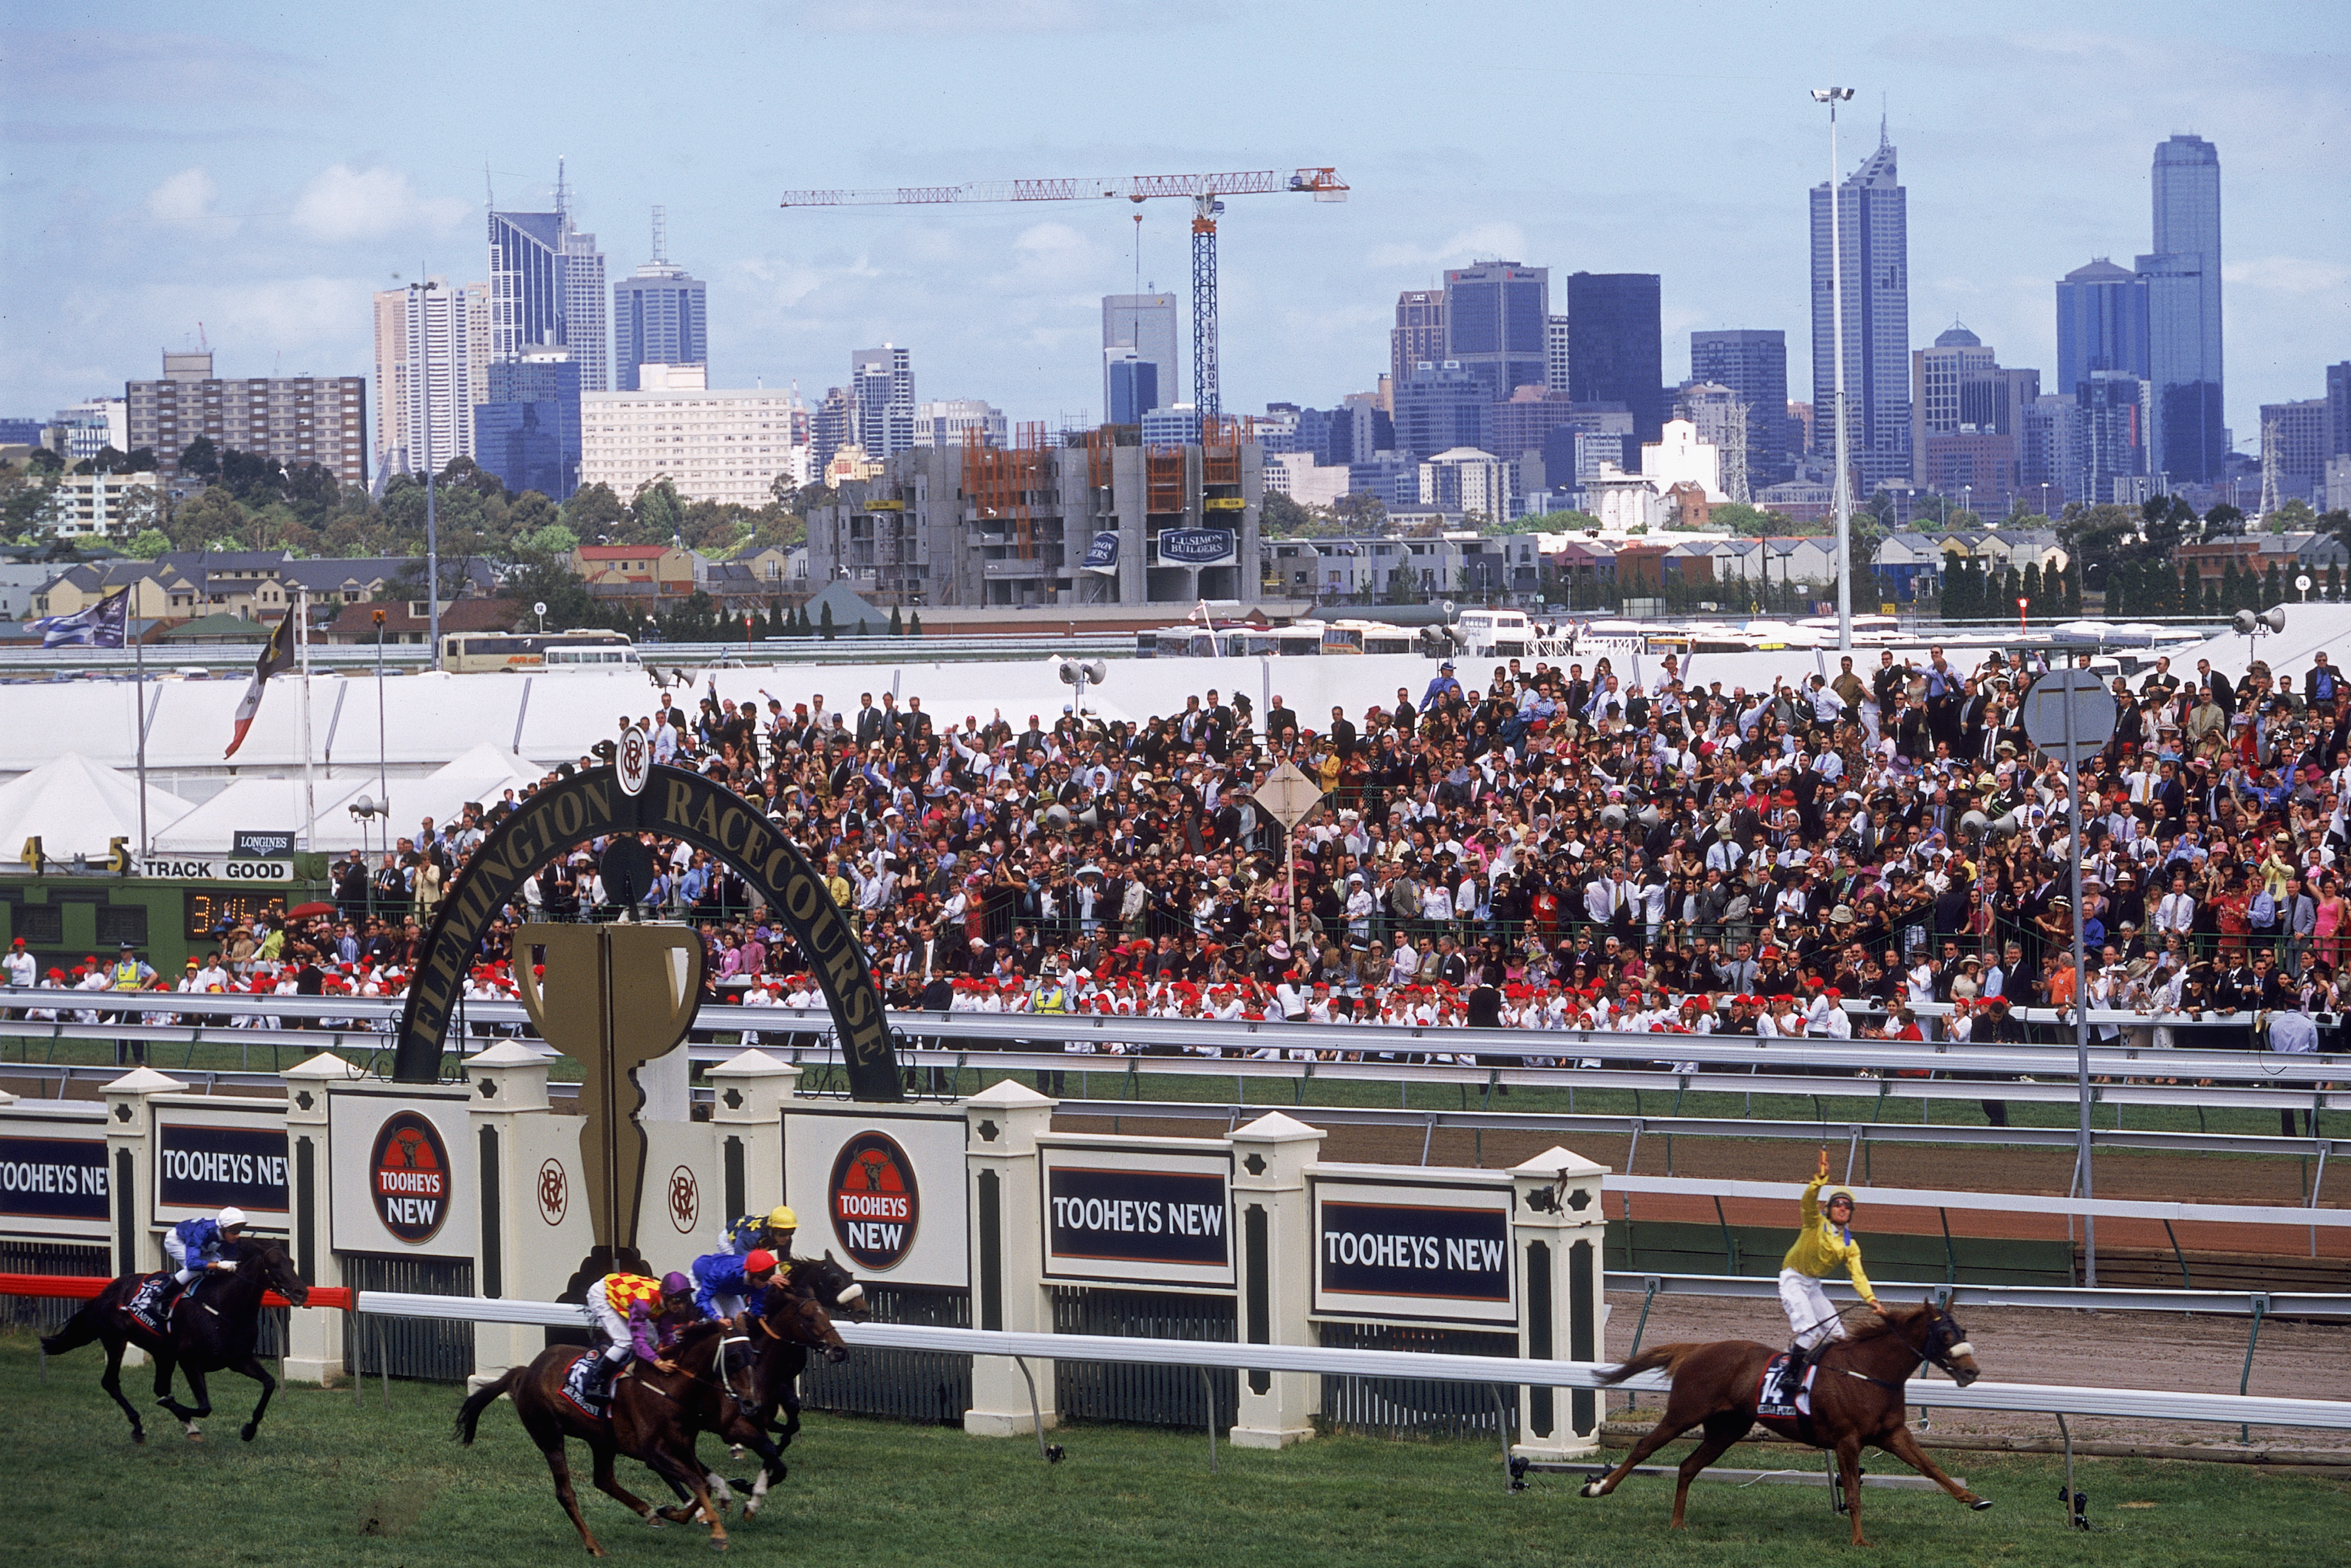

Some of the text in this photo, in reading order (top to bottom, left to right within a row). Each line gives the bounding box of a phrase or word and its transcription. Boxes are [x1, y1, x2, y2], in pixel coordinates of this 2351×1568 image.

[1207, 346, 1215, 389] SIMON
[1171, 543, 1223, 553] BUILDERS
[1535, 594, 1545, 604] 10
[21, 836, 39, 871] 4
[107, 836, 125, 872] 5
[240, 836, 287, 848] LONGINES
[144, 861, 284, 879] TRACK GOOD
[412, 777, 889, 1068] FLEMINGTON RACECOURSE
[82, 1166, 110, 1195] NE
[162, 1149, 253, 1184] TOOHEYS
[381, 1171, 441, 1193] TOOHEYS
[387, 1197, 437, 1225] NEW
[840, 1195, 907, 1217] TOOHEYS
[1052, 1196, 1223, 1237] TOOHEYS NEW
[847, 1221, 904, 1251] NEW
[1324, 1231, 1504, 1272] TOOHEYS NEW
[1761, 1372, 1784, 1404] 14
